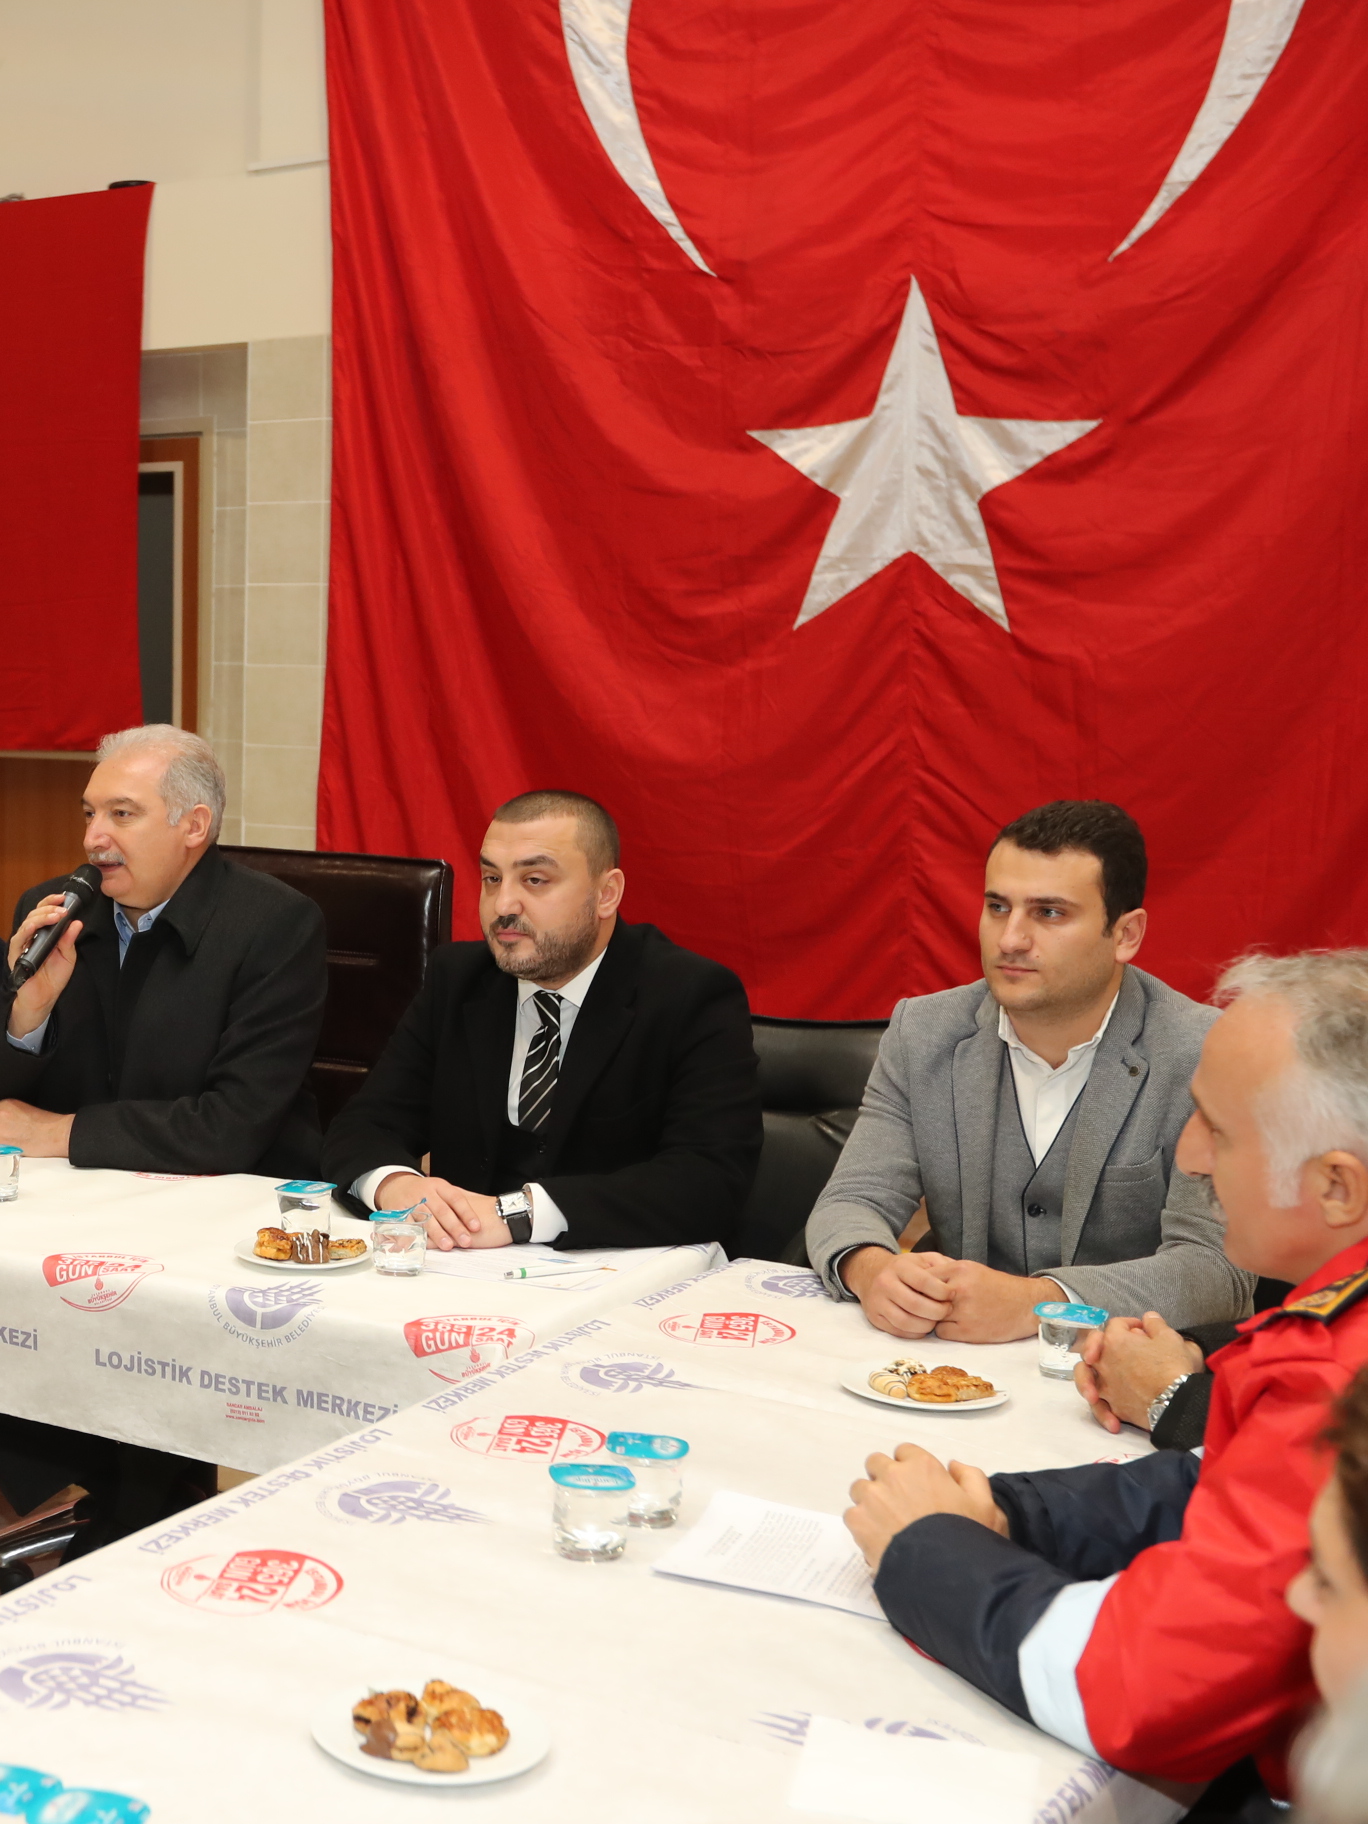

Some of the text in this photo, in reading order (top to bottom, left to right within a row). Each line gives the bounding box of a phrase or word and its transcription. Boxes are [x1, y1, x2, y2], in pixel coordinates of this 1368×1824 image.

[632, 1281, 692, 1311] MERKEZİ
[222, 1321, 283, 1349] BÜYÜKŞEHİR
[420, 1321, 468, 1333] 365
[477, 1327, 517, 1338] 24
[541, 1319, 612, 1352] LOJİSTİK
[729, 1315, 756, 1331] 365
[95, 1348, 192, 1385] LOJİSTİK
[200, 1370, 288, 1405] DESTEK
[420, 1372, 496, 1415] MERKEZİ
[511, 1437, 551, 1454] 24
[137, 1427, 393, 1556] LOJİSTİK DESTEK MERKEZİ
[257, 1559, 299, 1585] 365
